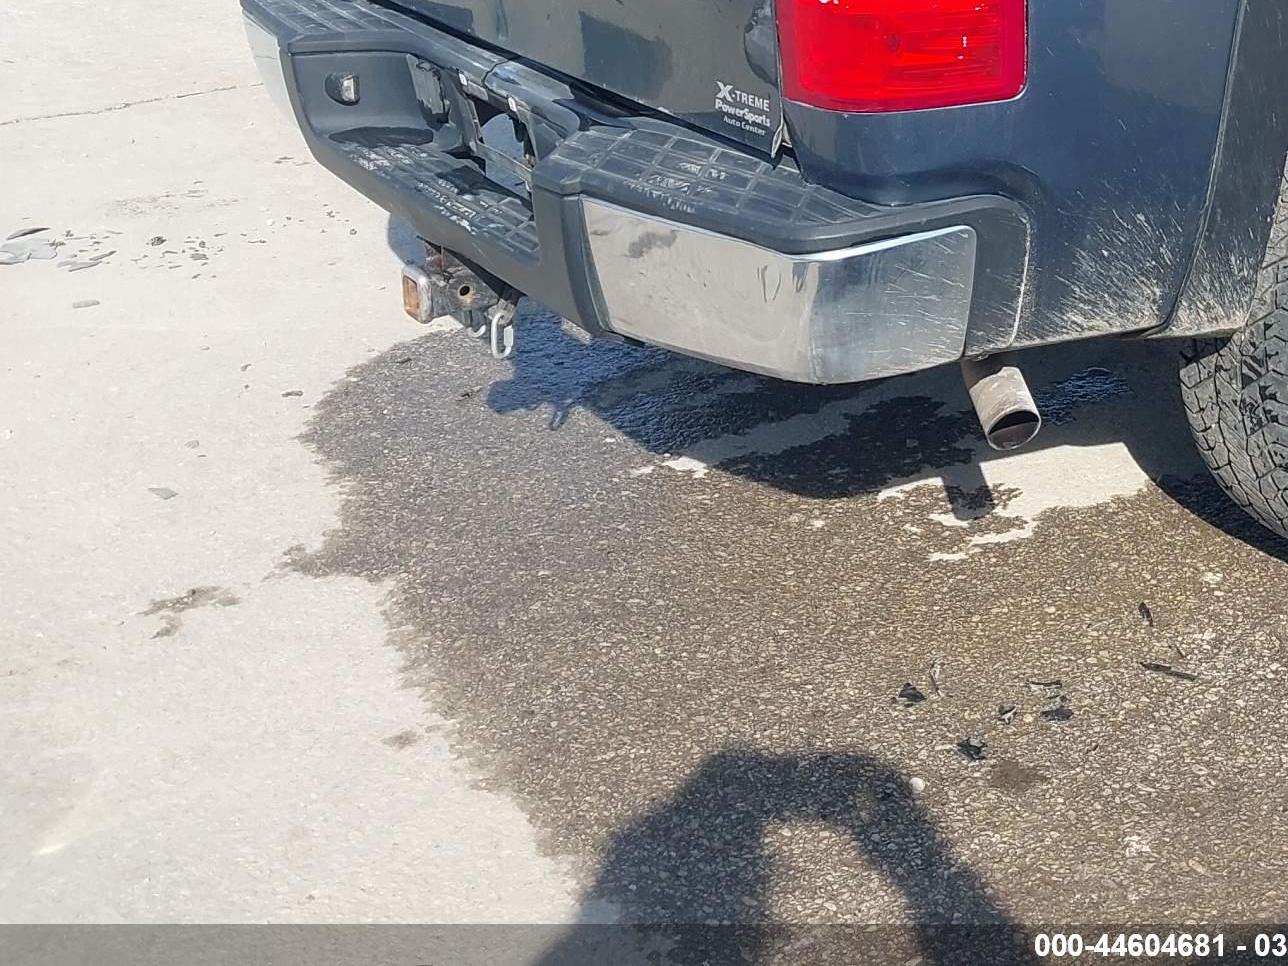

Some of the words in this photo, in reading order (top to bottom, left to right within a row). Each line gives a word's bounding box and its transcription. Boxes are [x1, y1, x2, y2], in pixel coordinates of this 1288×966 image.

[715, 80, 770, 112] X-TREME
[723, 115, 741, 127] Auto
[741, 121, 766, 136] Center
